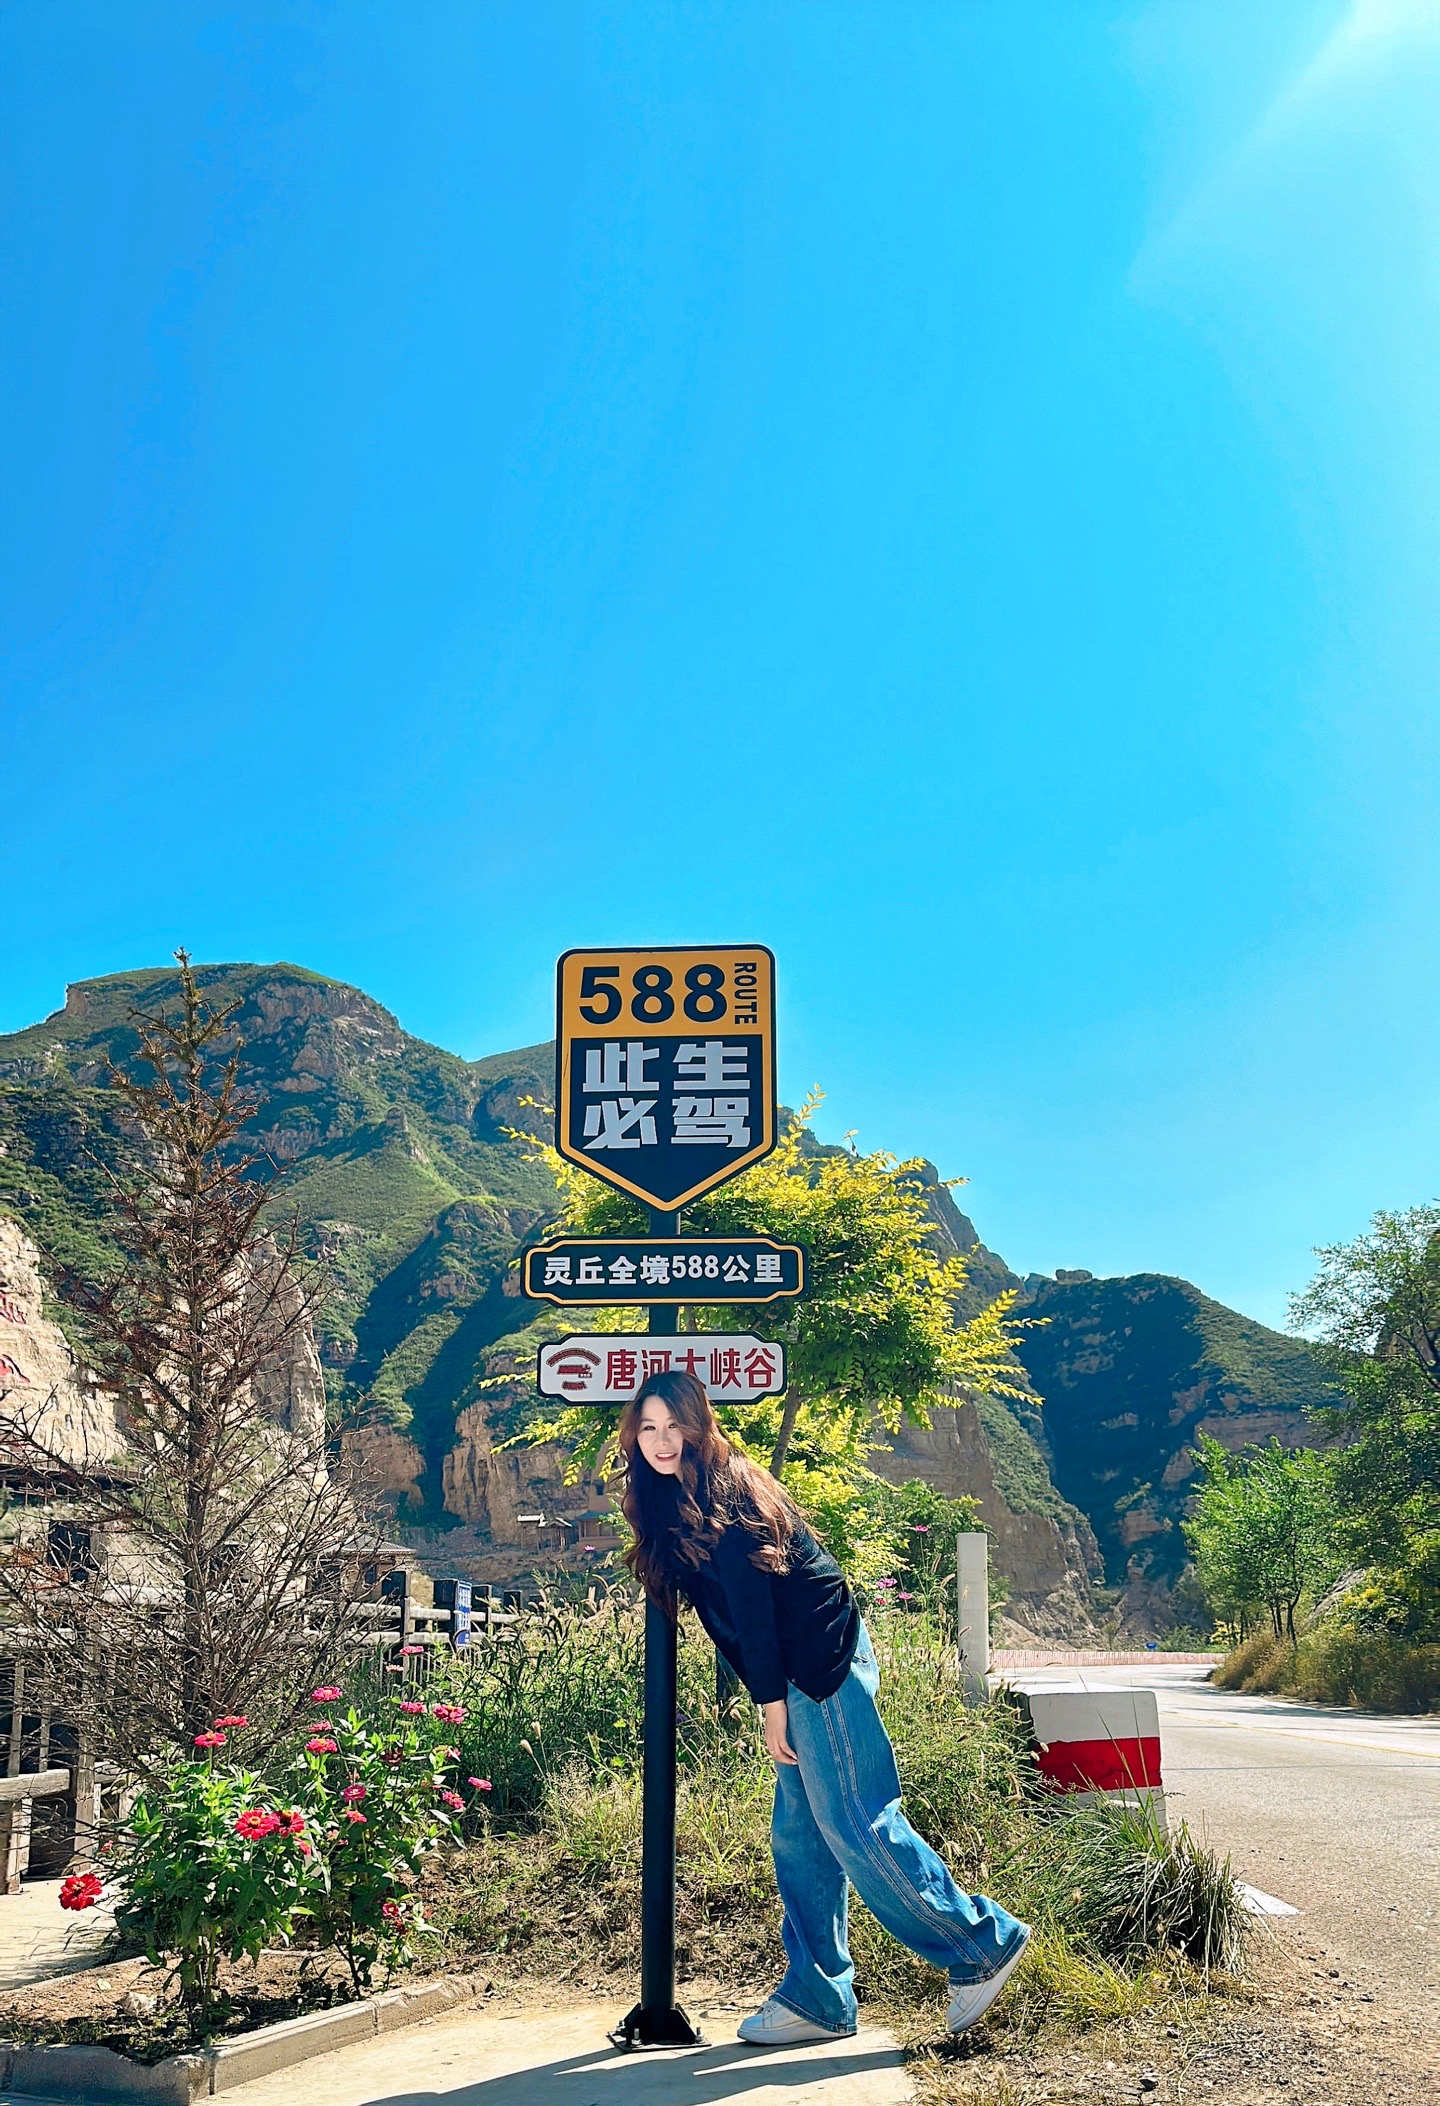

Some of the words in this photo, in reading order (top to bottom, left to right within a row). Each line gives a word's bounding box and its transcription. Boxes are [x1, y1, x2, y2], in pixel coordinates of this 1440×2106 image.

[579, 963, 727, 1025] 588
[734, 962, 758, 1025] ROUTE
[582, 1041, 750, 1092] 此生
[582, 1096, 750, 1149] 必驾
[542, 1254, 784, 1285] 灵丘全境588公里
